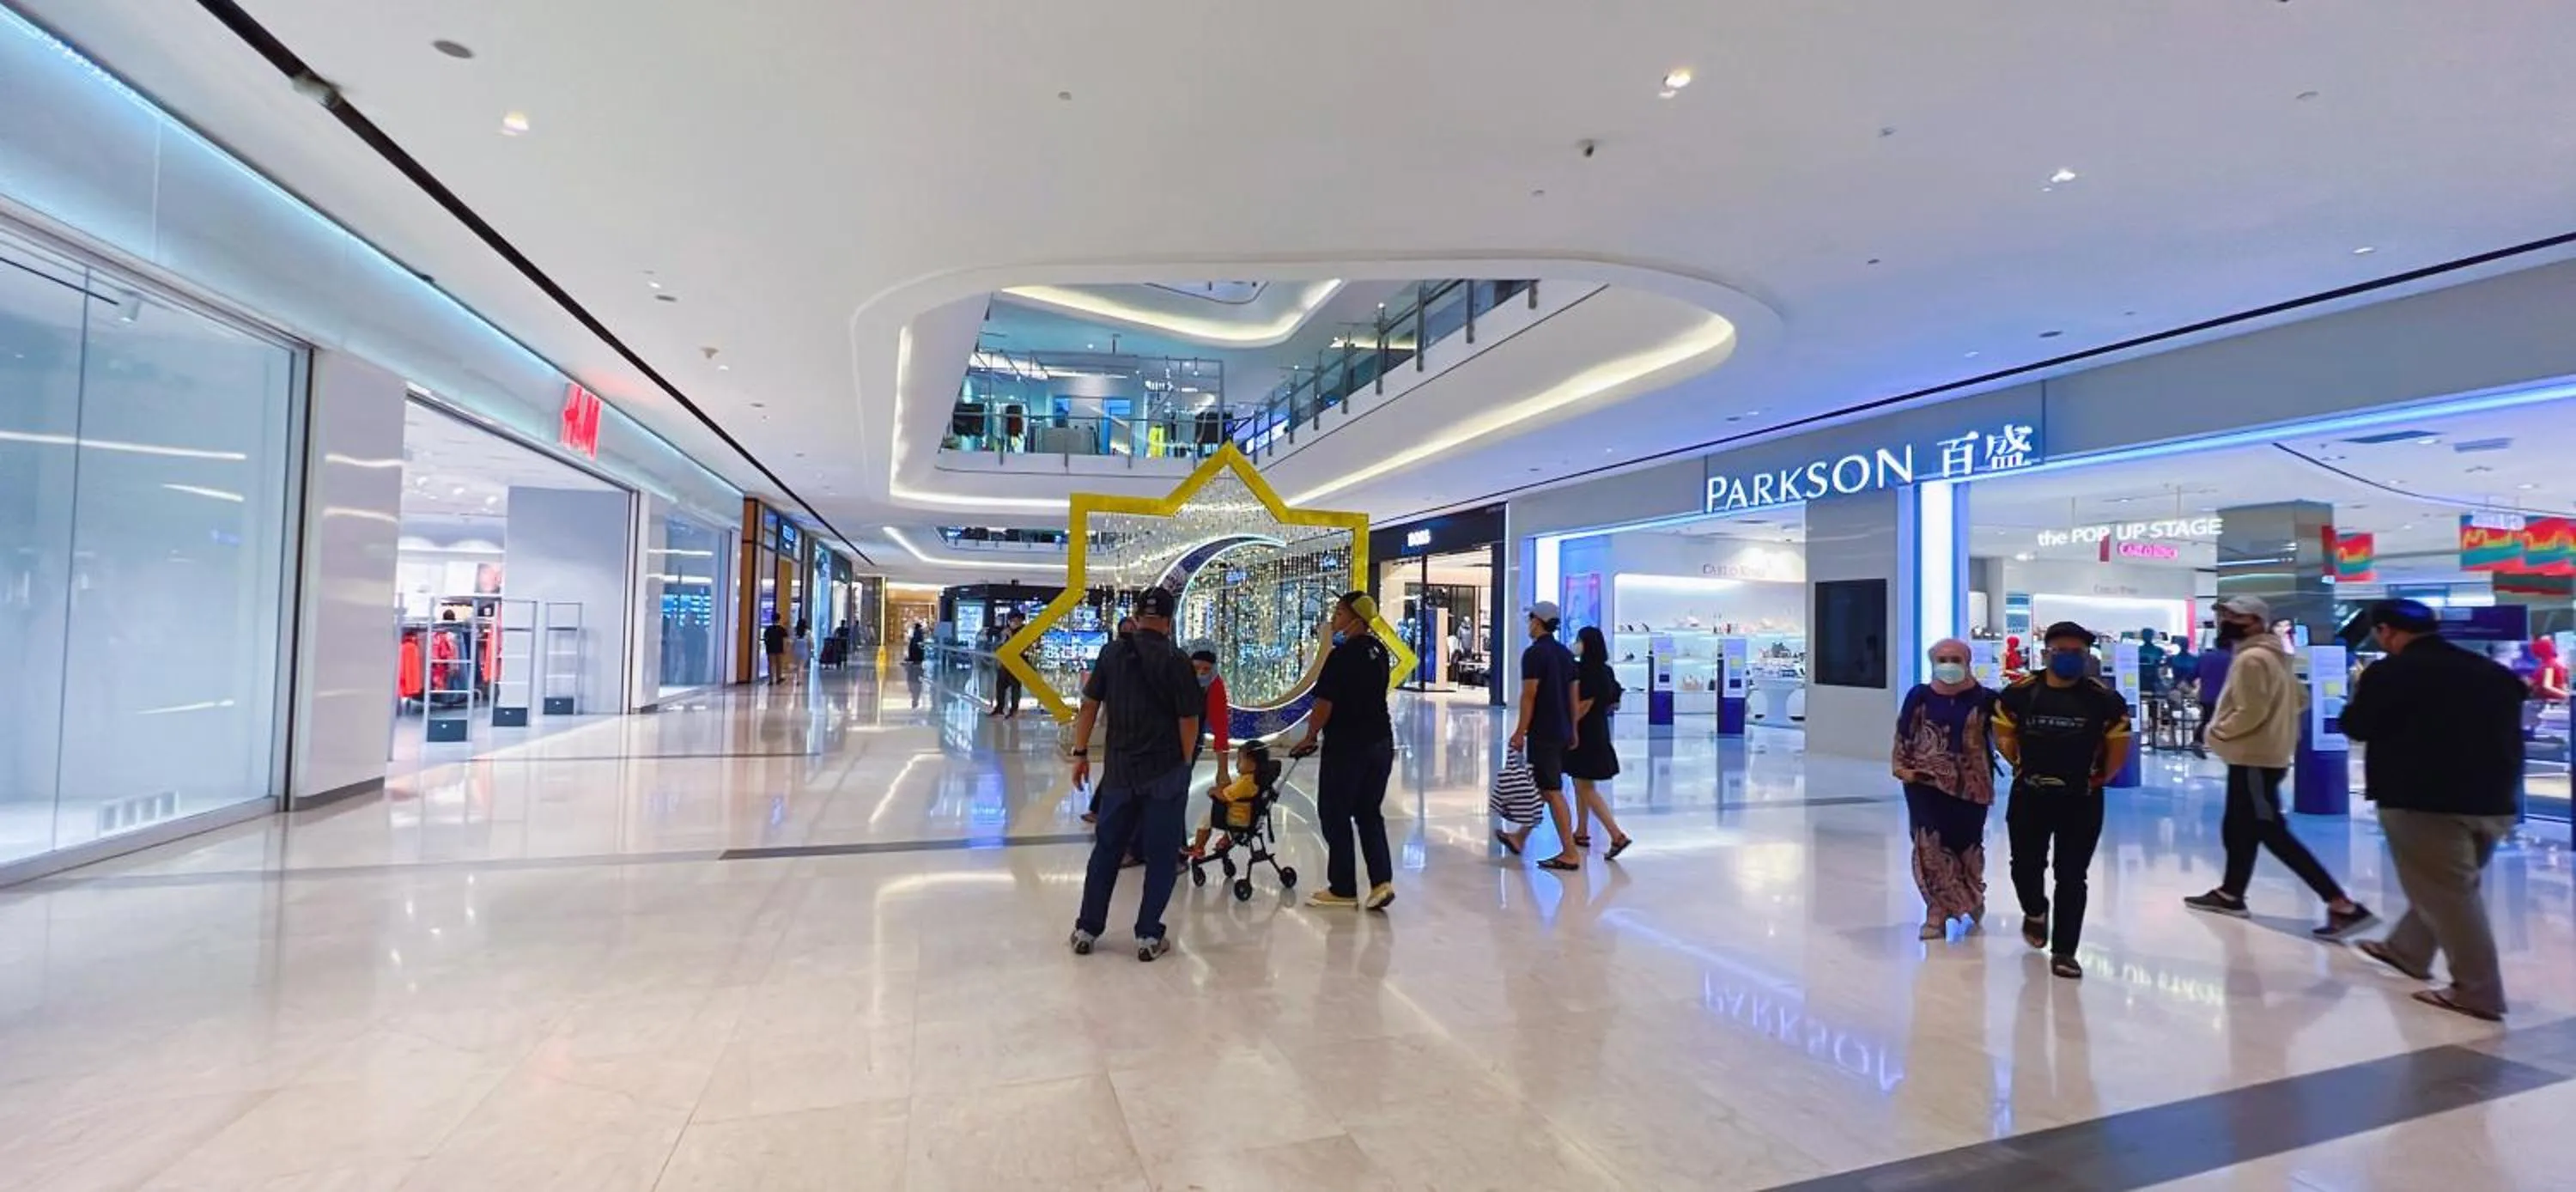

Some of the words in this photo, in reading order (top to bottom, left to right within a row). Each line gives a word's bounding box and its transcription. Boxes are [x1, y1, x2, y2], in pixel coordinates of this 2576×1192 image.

[1706, 443, 1913, 513] PARKSON
[1937, 424, 2033, 478] 百盛
[2038, 528, 2068, 546] the
[2070, 526, 2111, 543] POP
[2116, 522, 2146, 540] UP
[2148, 518, 2224, 538] STAGE
